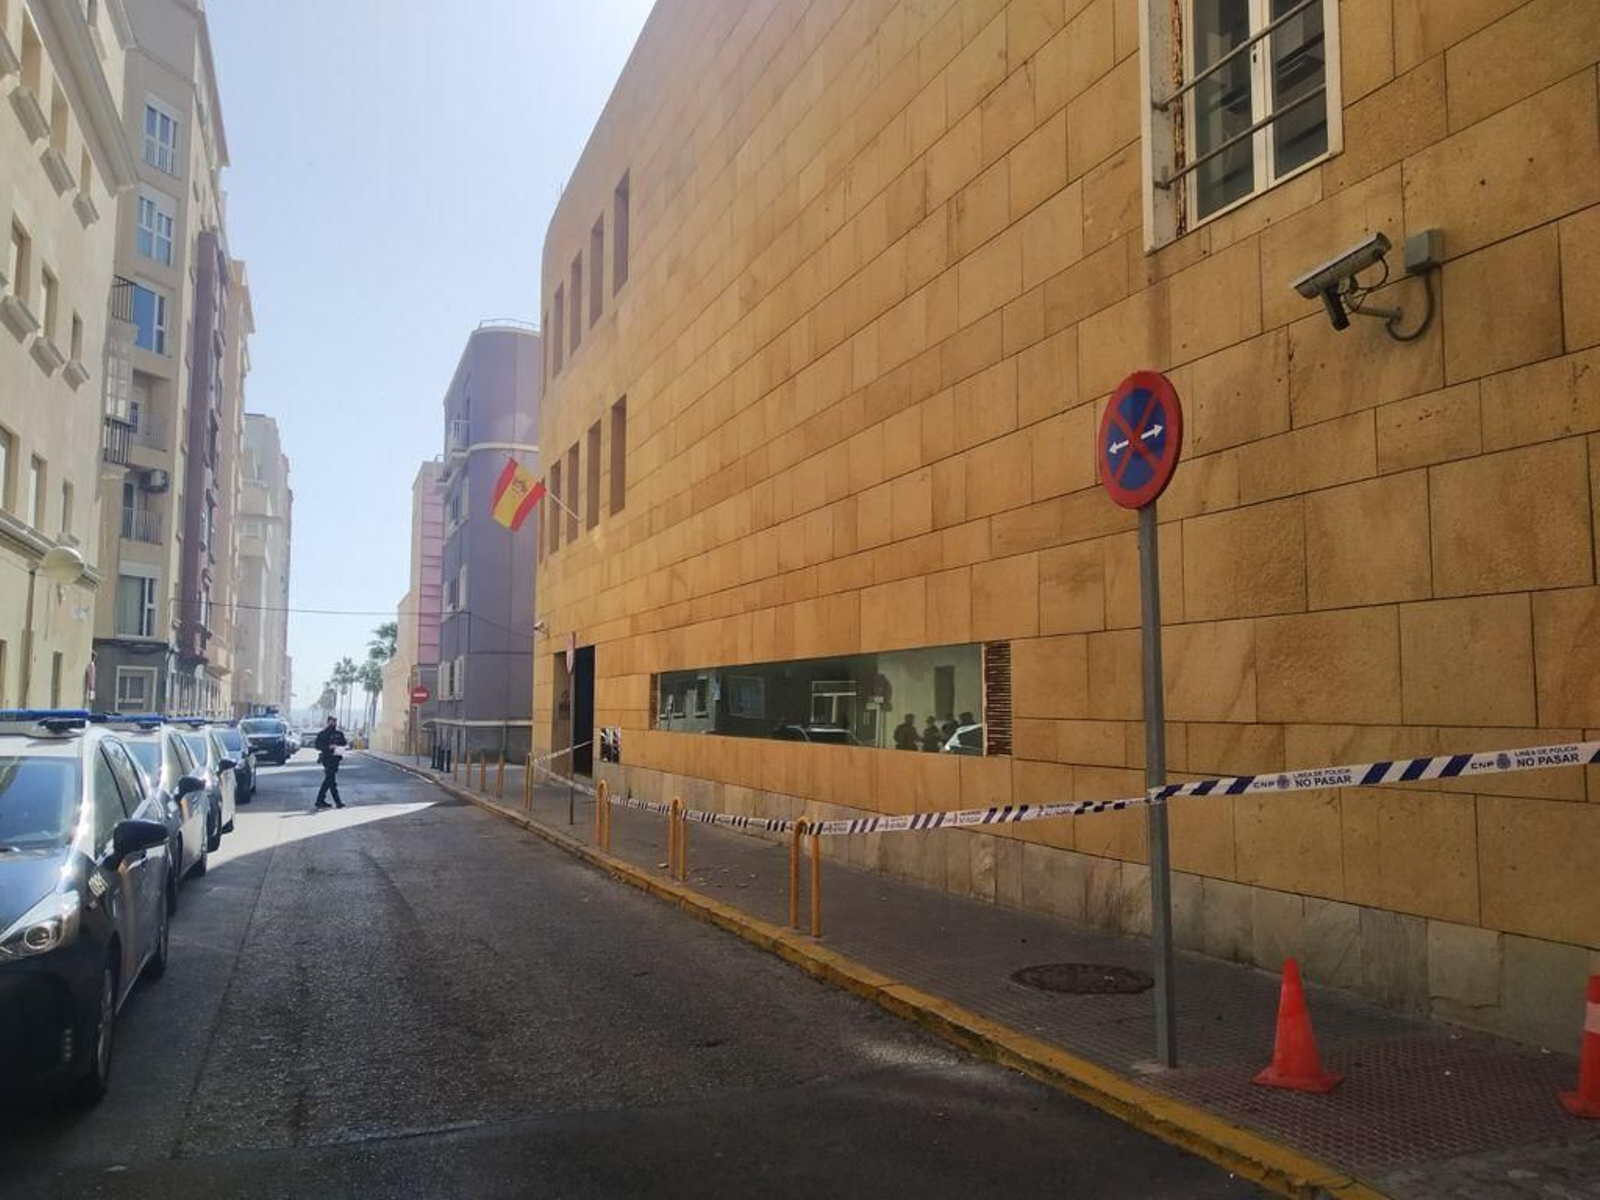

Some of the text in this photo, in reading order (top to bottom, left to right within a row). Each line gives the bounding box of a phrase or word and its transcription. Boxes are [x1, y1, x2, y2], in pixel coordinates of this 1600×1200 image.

[1471, 761, 1495, 770] CNP
[1516, 753, 1580, 768] NO PASAR
[1294, 774, 1352, 788] NO PASAR
